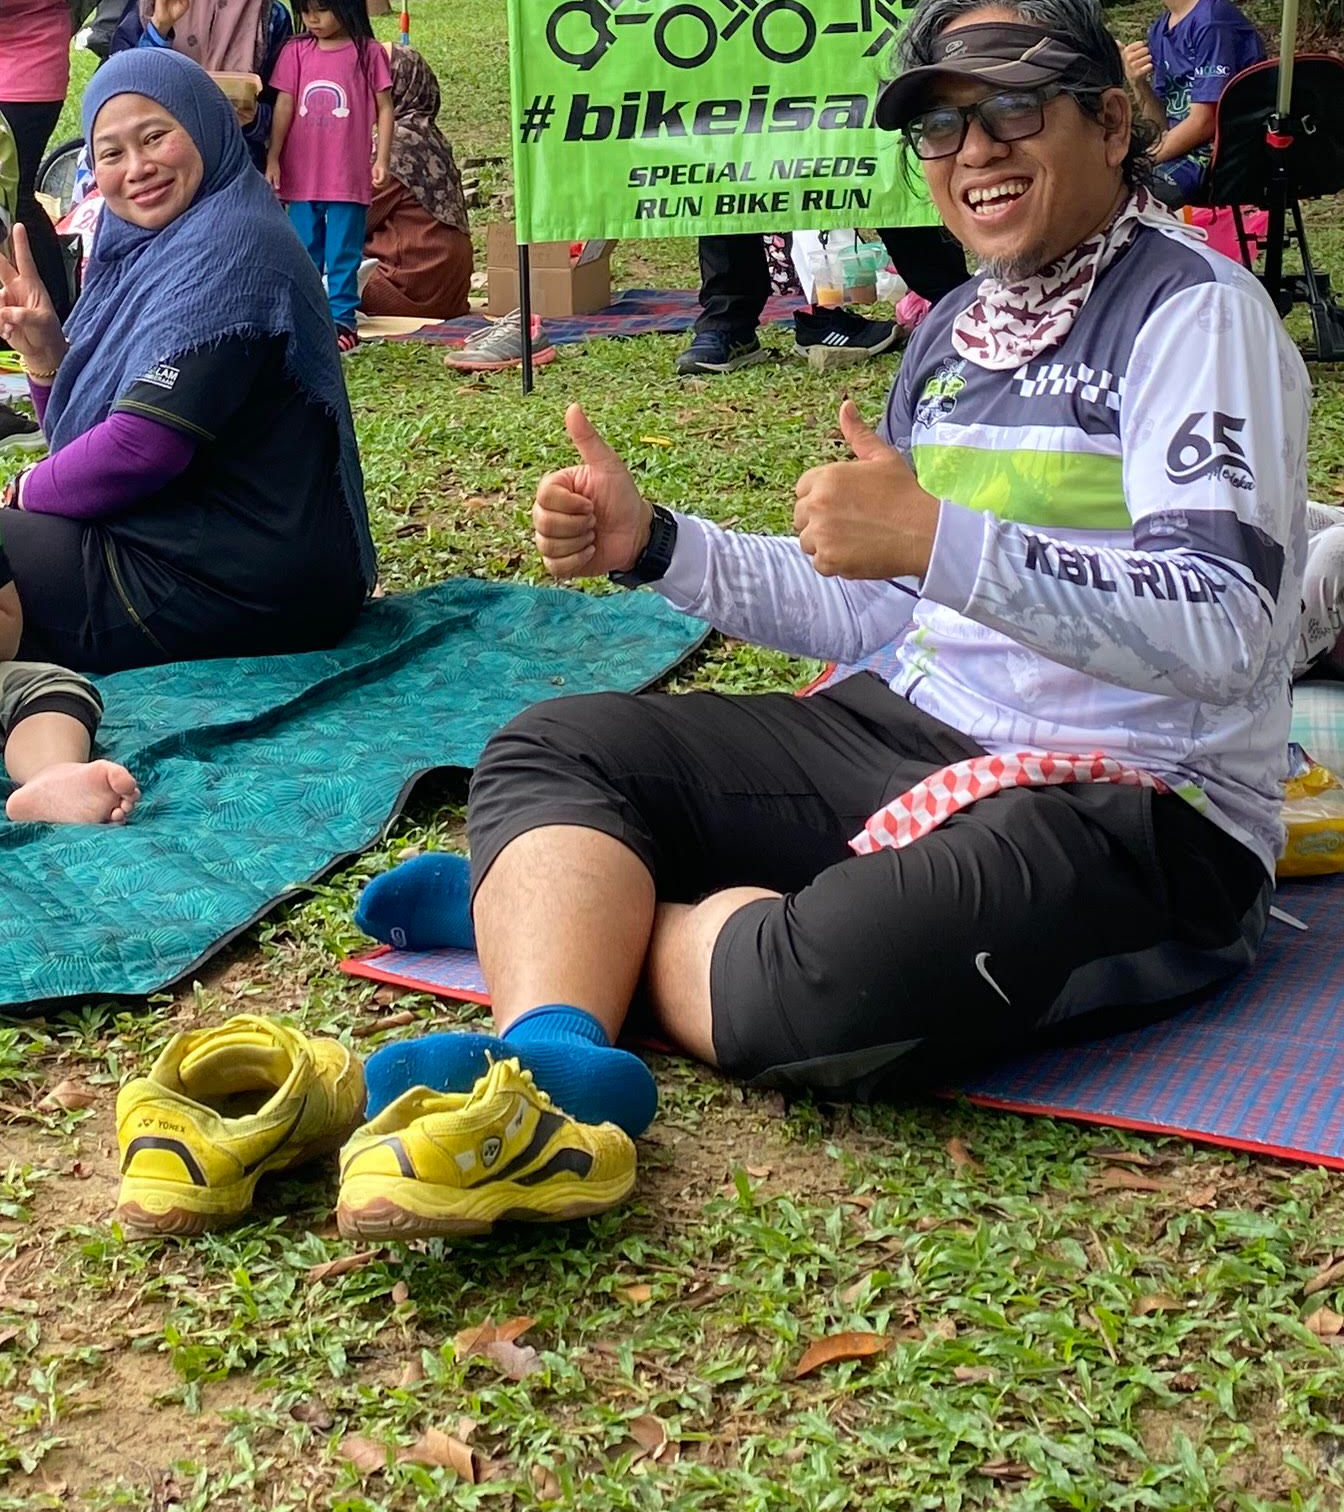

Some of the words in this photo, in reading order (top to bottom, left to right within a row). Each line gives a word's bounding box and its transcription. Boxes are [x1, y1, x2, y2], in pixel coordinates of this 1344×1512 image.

[520, 85, 876, 144] #bikeisa
[627, 159, 757, 189] SPECIAL
[769, 156, 878, 180] NEEDS
[634, 194, 704, 221] RUN
[714, 191, 790, 216] BIKE
[800, 187, 873, 212] RUN
[1165, 410, 1252, 485] 65
[158, 1119, 186, 1133] YONEX
